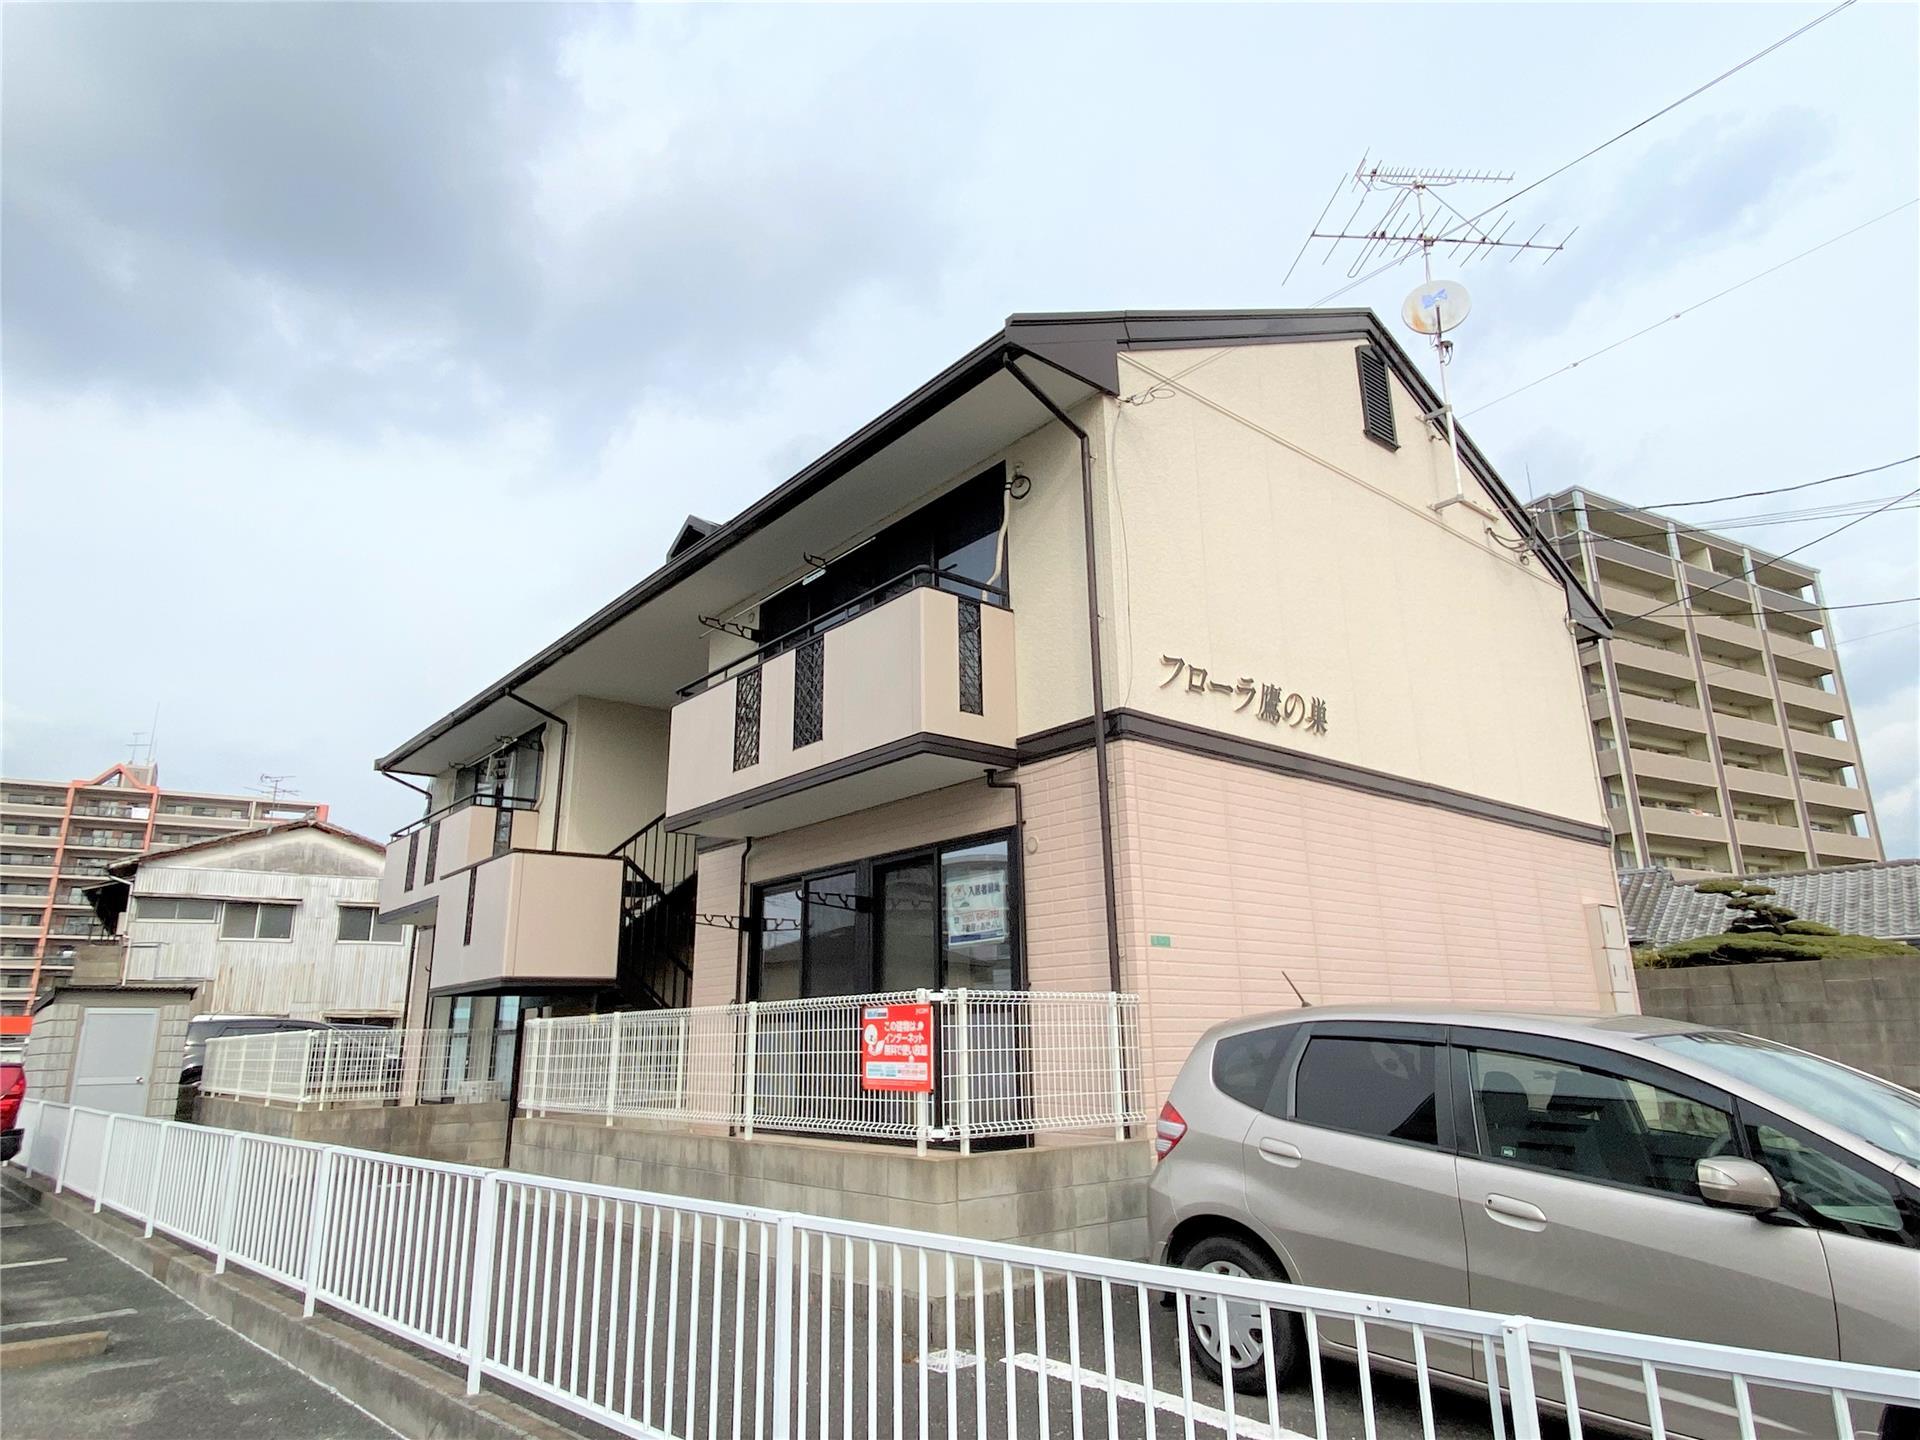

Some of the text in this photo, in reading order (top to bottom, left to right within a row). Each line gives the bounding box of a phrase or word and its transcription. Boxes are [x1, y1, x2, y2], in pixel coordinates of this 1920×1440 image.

[1159, 654, 1327, 735] フローラ鷹の巣
[884, 1033, 925, 1044] インターネット
